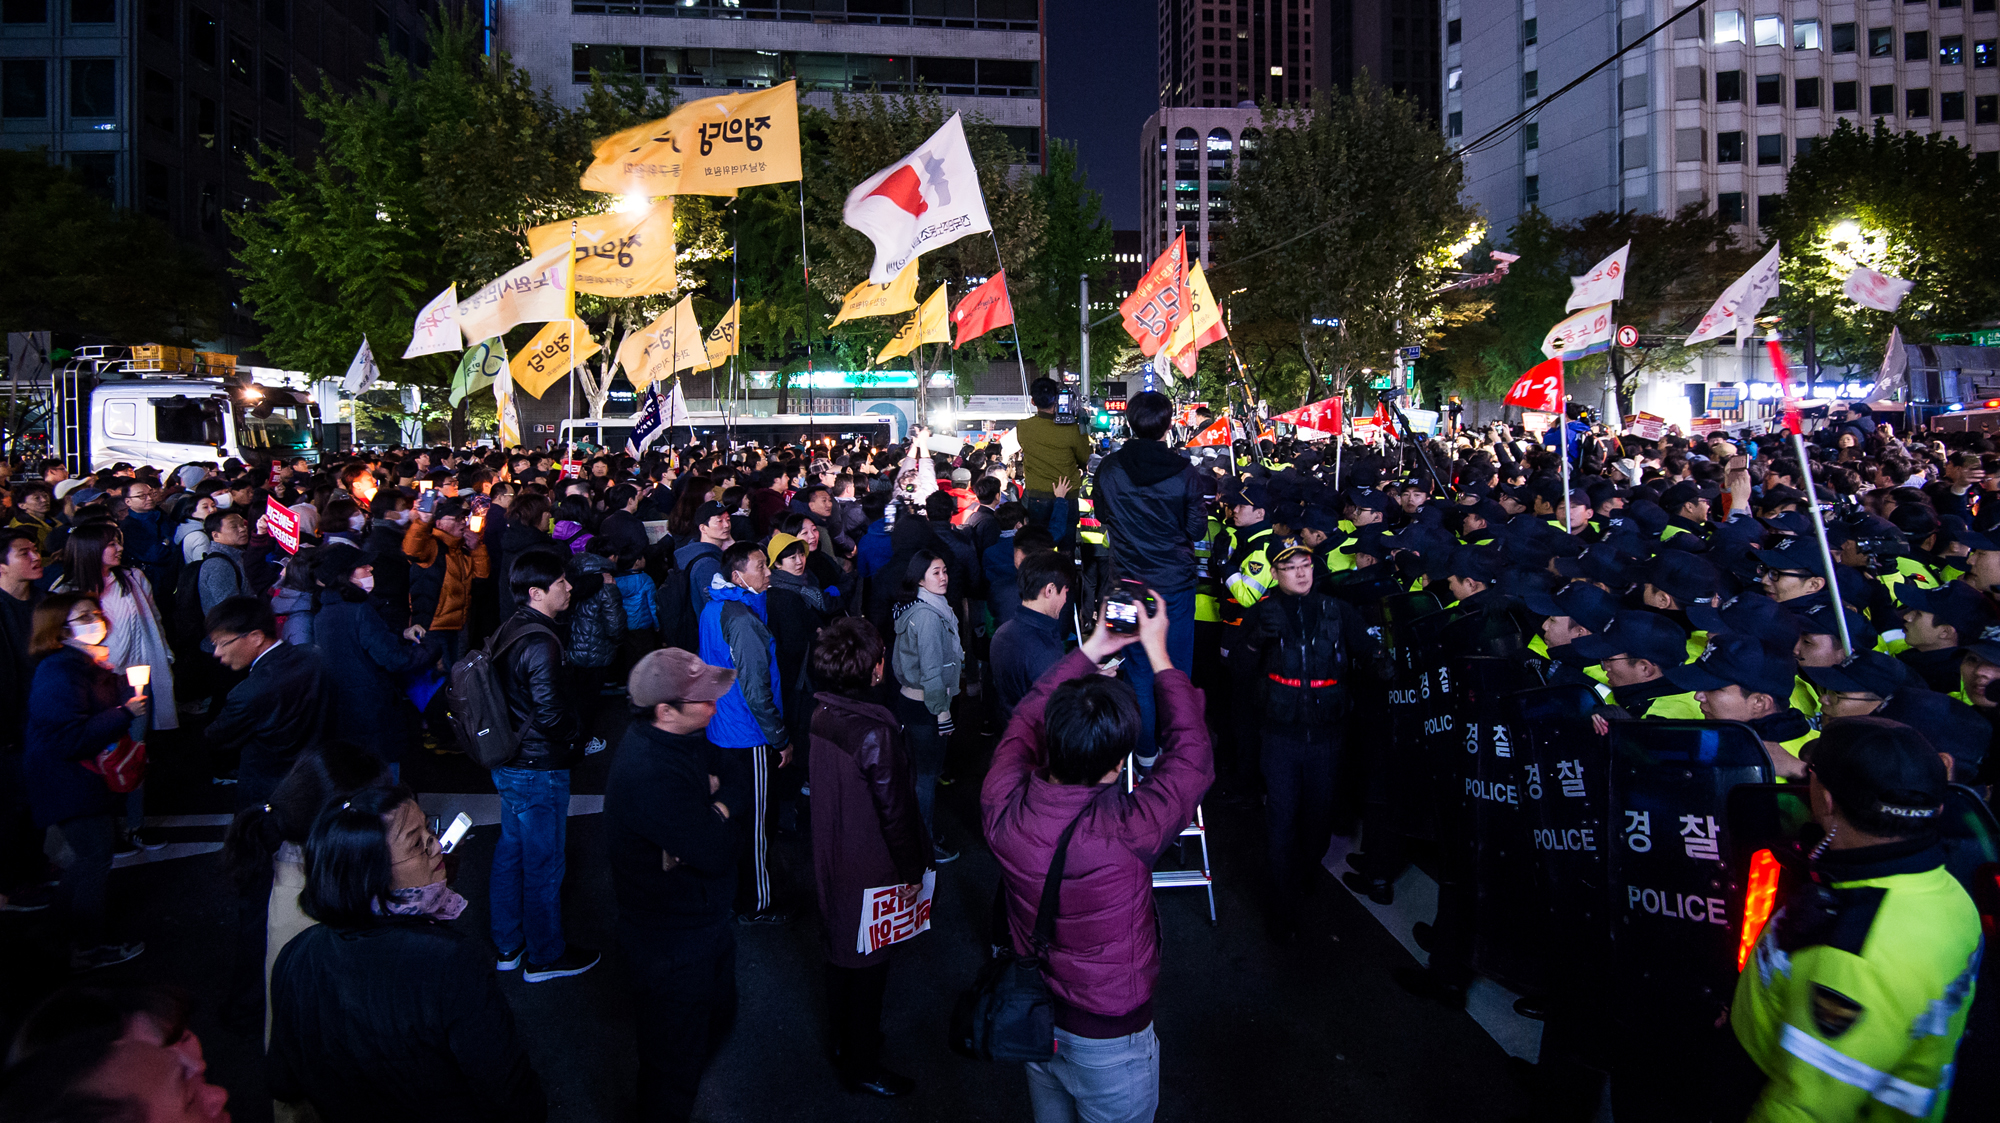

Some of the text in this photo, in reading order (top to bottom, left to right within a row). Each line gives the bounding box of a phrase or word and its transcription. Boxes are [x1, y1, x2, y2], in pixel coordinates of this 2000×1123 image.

[1512, 376, 1559, 399] 47-2
[1206, 426, 1229, 440] 43-3
[1388, 689, 1419, 704] POLIC
[1465, 777, 1519, 805] POLICE
[1880, 804, 1935, 818] POLICE
[1533, 828, 1597, 851] POLICE
[1626, 884, 1729, 925] POLICE
